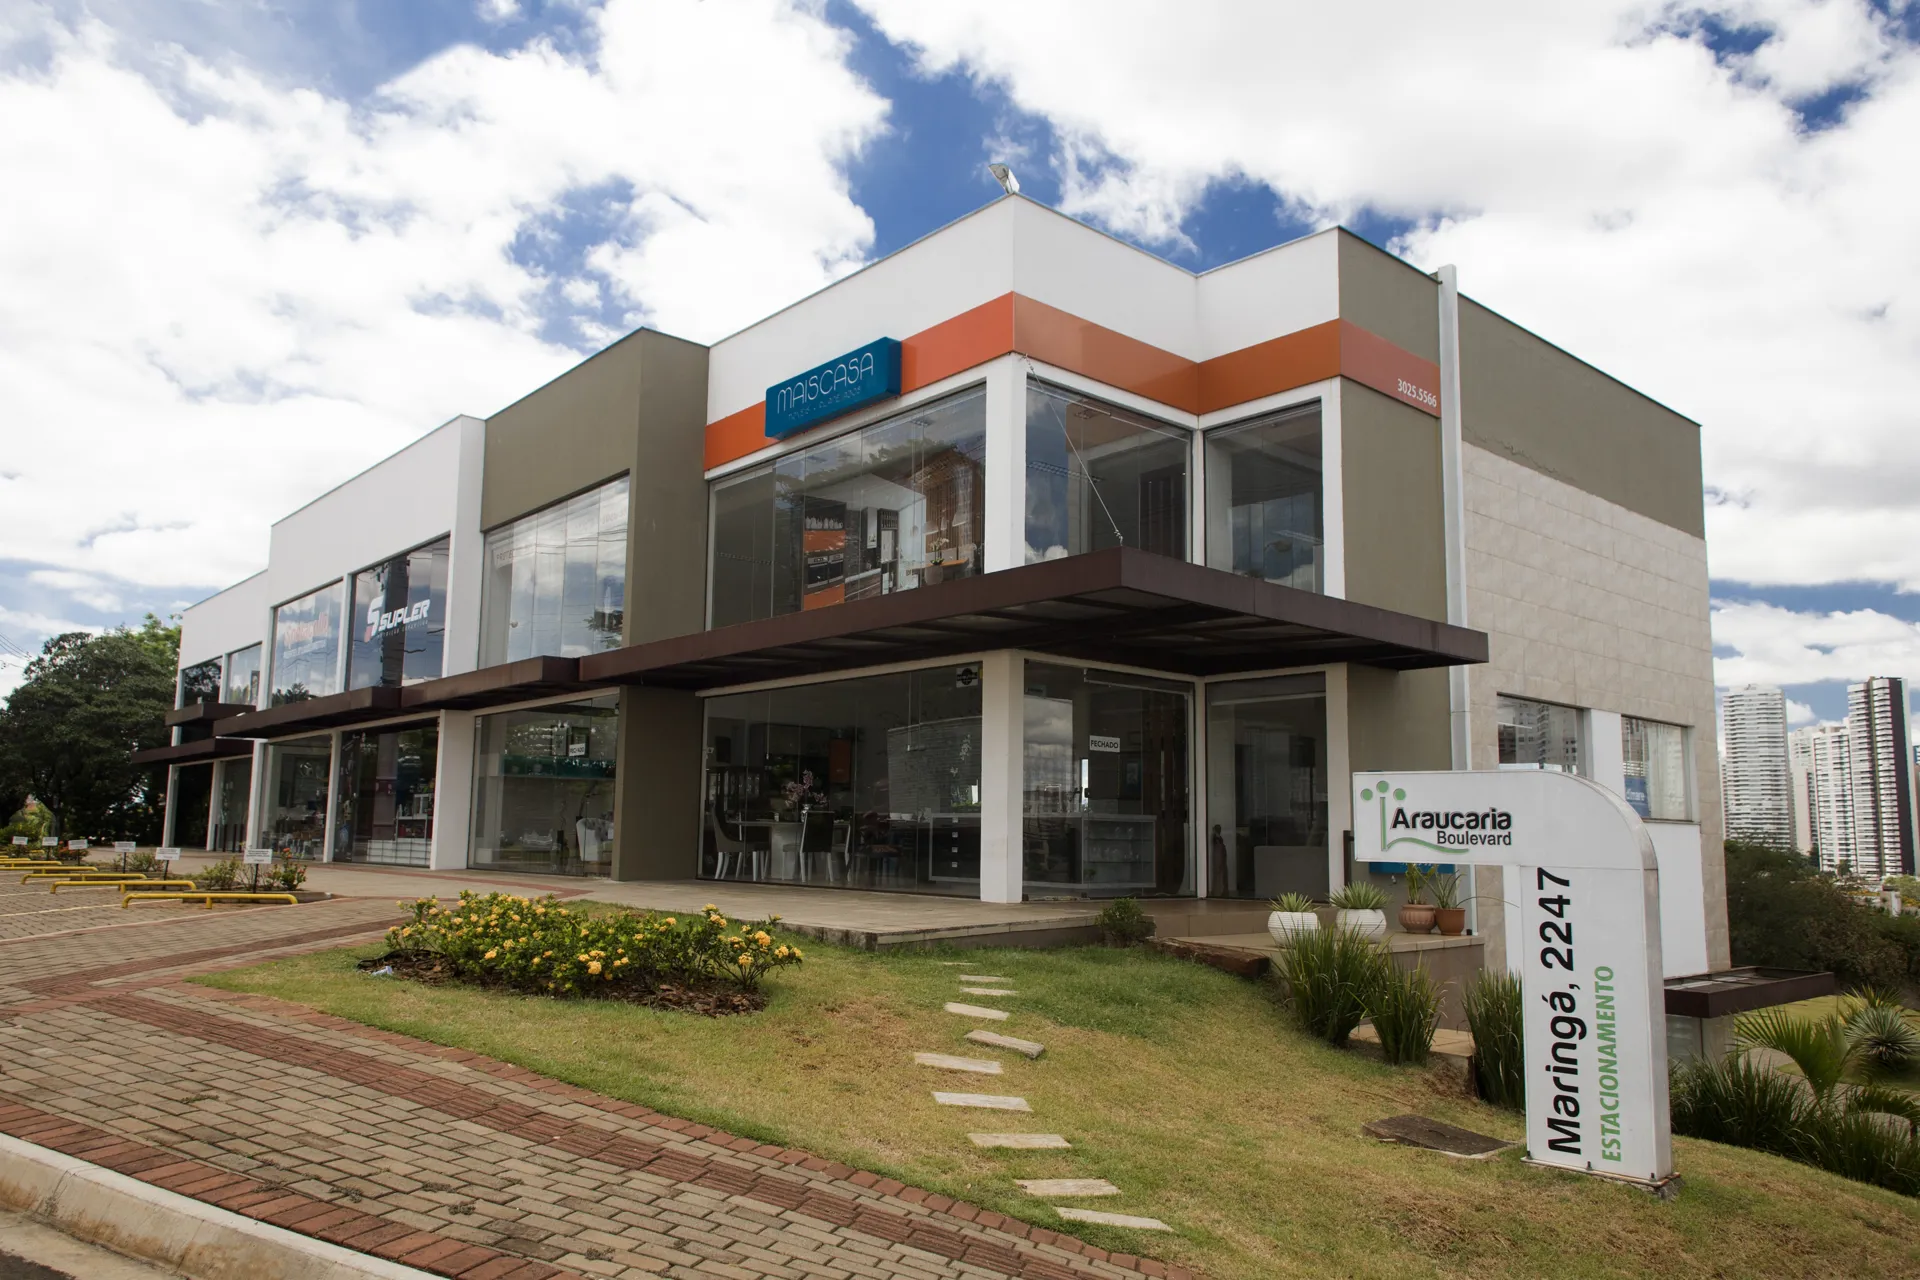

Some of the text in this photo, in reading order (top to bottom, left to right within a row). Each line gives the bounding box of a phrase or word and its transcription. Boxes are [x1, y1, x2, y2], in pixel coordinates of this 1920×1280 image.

[777, 353, 874, 414] MAISCASA
[1397, 378, 1437, 408] 3025.5566
[378, 599, 431, 632] SUPLER
[1091, 740, 1118, 749] FECHADO
[1391, 808, 1512, 830] Araucaria
[1436, 830, 1512, 846] Boulevard
[1537, 866, 1588, 1156] Maringá, 2247
[1593, 965, 1622, 1162] ESTACIONAMENTO
